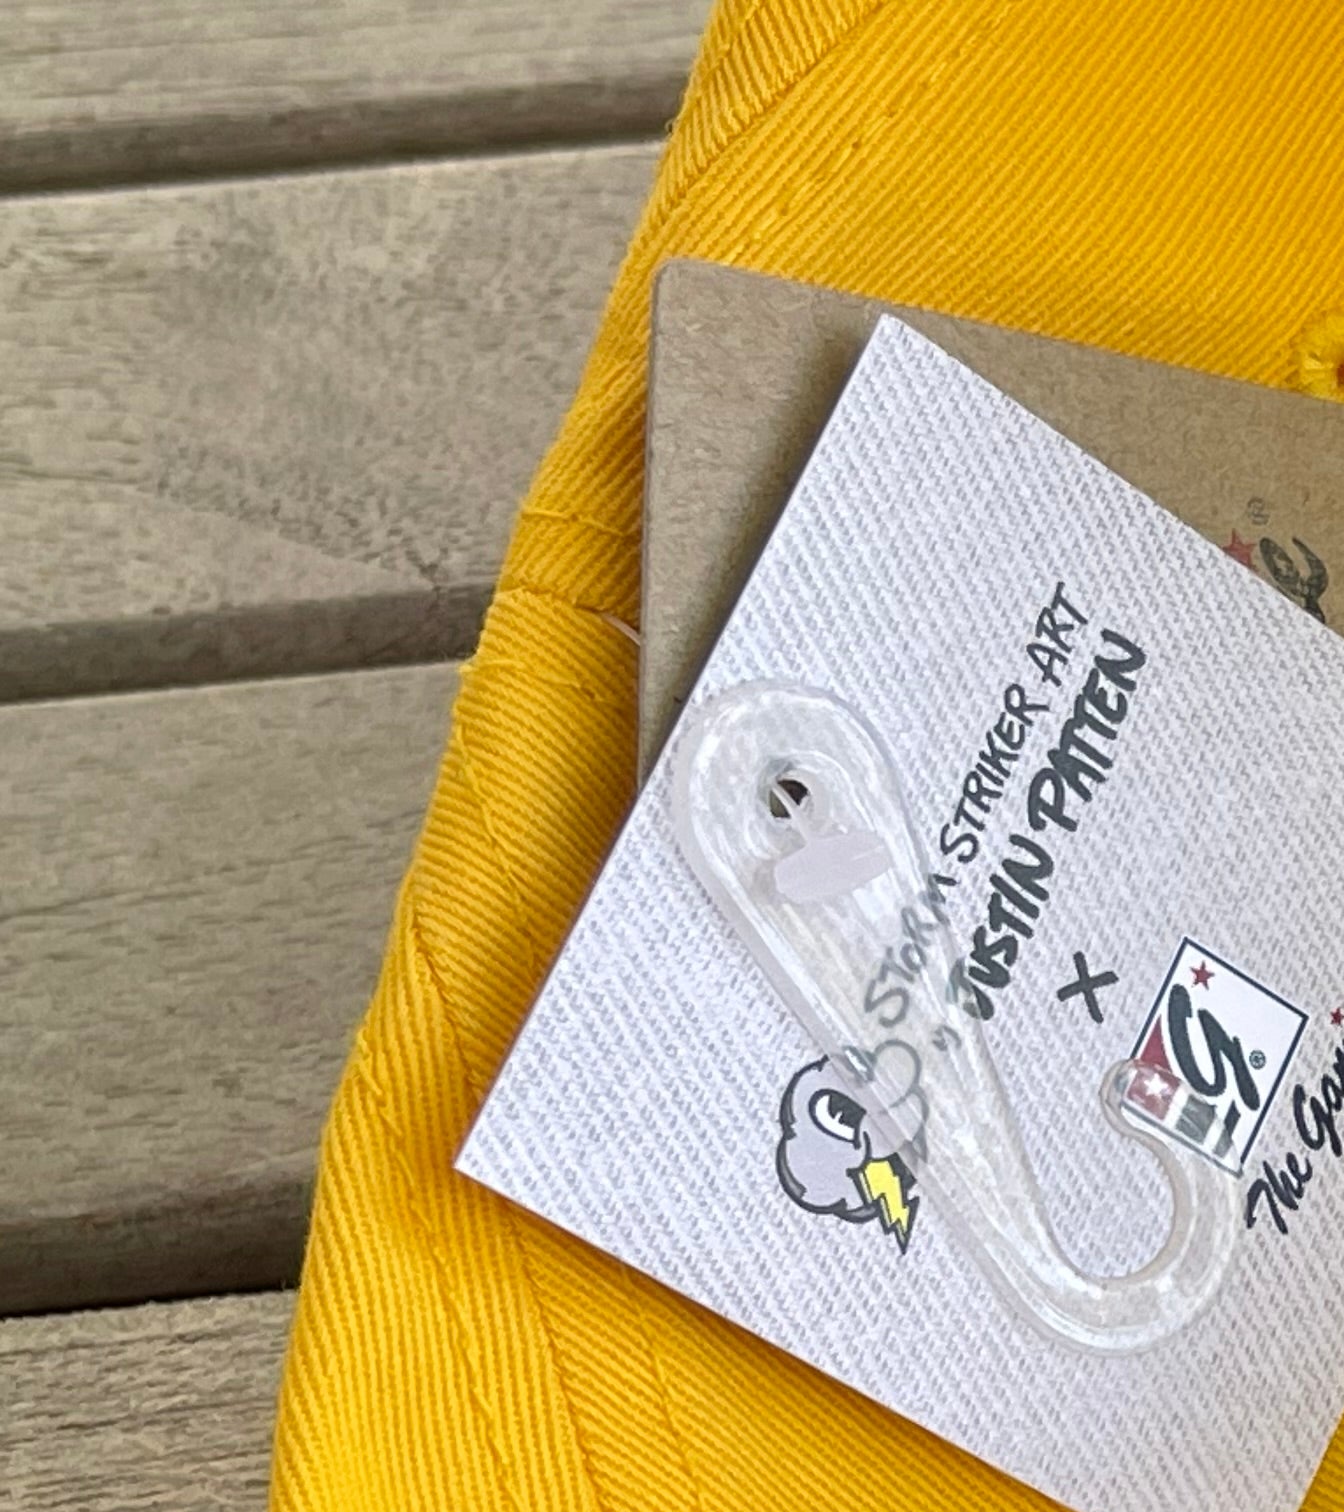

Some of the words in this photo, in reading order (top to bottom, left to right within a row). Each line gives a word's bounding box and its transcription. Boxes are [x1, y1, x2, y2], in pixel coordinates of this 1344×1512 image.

[940, 683, 1051, 864] STRIKER
[1027, 581, 1090, 688] ART
[1027, 628, 1147, 832] PATTEN
[1243, 1152, 1313, 1235] The
